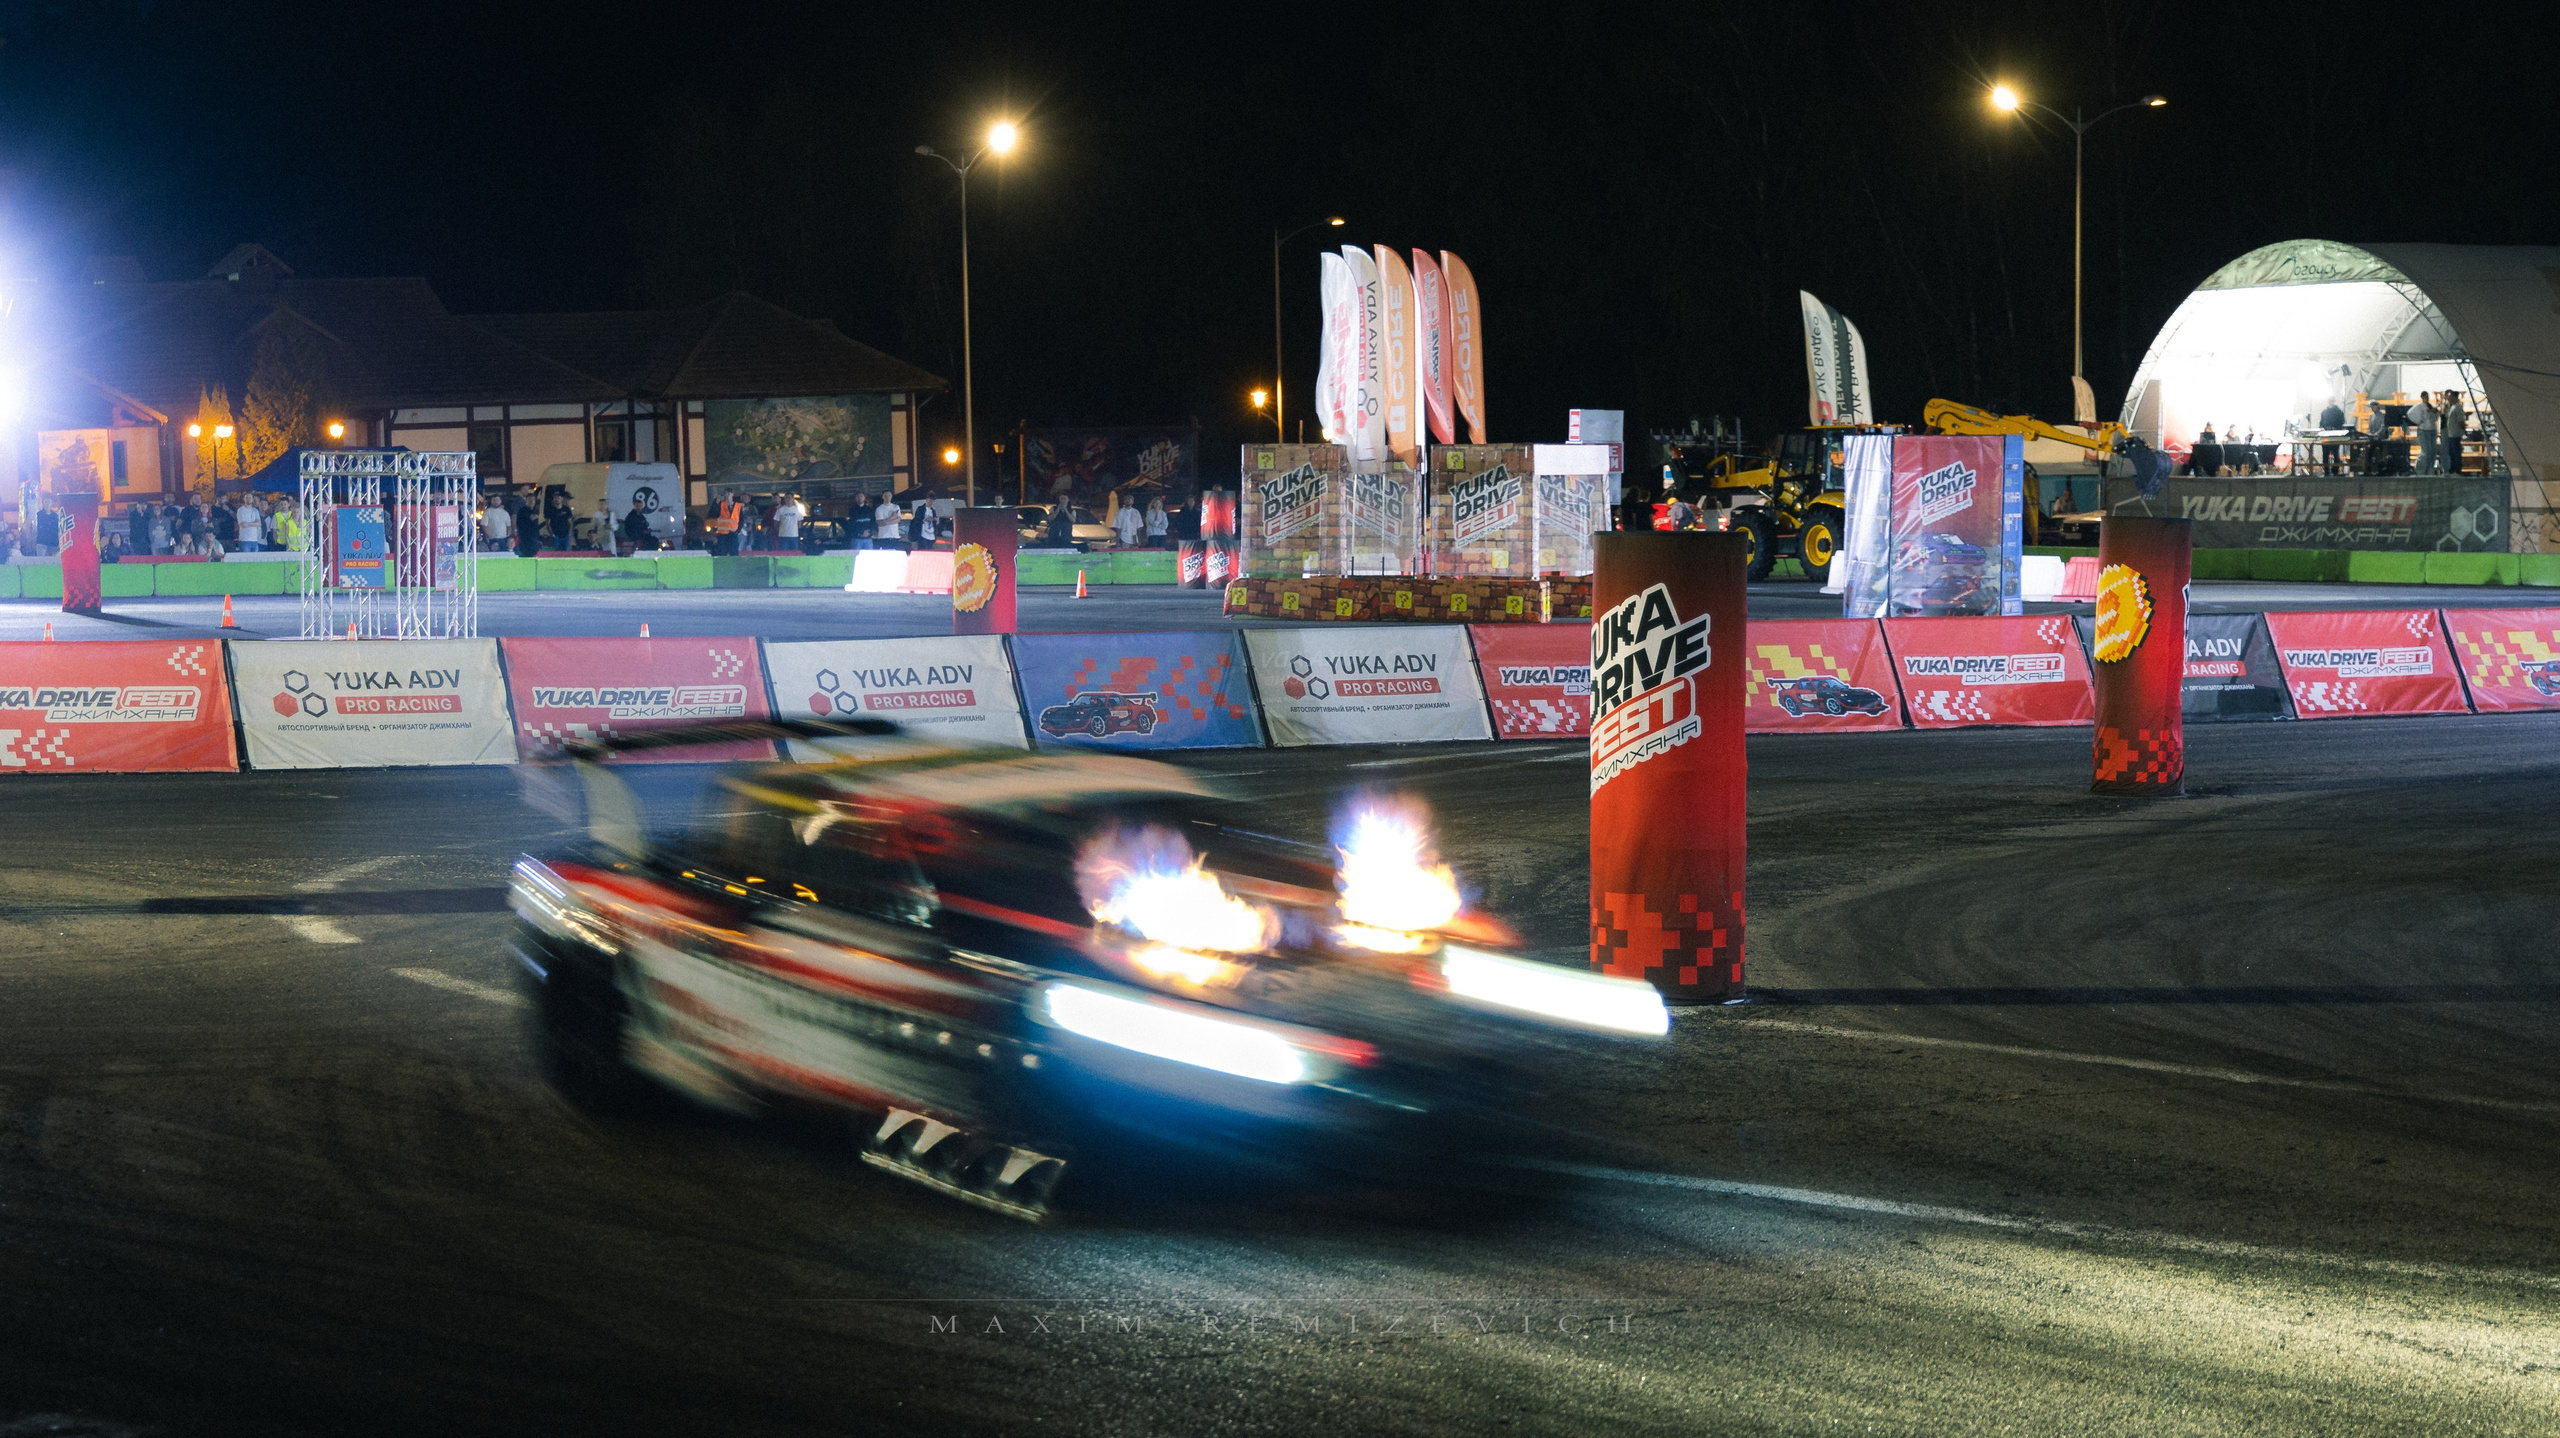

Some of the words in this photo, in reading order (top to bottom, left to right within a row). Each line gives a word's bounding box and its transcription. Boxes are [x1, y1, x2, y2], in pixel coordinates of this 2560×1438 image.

[1260, 464, 1315, 501] YUKA
[1450, 465, 1509, 503] YUKA
[1920, 463, 1964, 491] YUKA
[1922, 472, 1974, 505] DRIVE
[635, 491, 658, 510] 86
[1264, 475, 1327, 521] DRIVE
[1455, 478, 1520, 521] DRIVE
[1924, 489, 1967, 517] FEST
[1267, 499, 1320, 535] FEST
[2180, 496, 2246, 522] YUKA
[2249, 496, 2334, 522] DRIVE
[2340, 498, 2416, 521] FEST
[1457, 501, 1514, 538] FEST
[2259, 526, 2411, 543] ДЖИМХАНА
[1592, 588, 1677, 670] UKA
[2205, 638, 2242, 657] ADV
[1324, 655, 1389, 675] YUKA
[1393, 654, 1437, 673] ADV
[1906, 659, 1950, 673] YUKA
[1953, 658, 2006, 673] DRIVE
[2013, 657, 2059, 671] FEST
[2286, 652, 2327, 666] YUKA
[2330, 652, 2377, 666] DRIVE
[2385, 650, 2428, 664] FEST
[853, 667, 922, 688] YUKA
[927, 665, 973, 685] ADV
[1501, 669, 1550, 684] YUKA
[1965, 672, 2063, 683] ДЖИМХАНА
[2190, 663, 2239, 675] RACING
[2341, 665, 2431, 676] ДЖИМХАНА
[324, 671, 402, 690] YUKA
[408, 669, 460, 689] ADV
[1343, 682, 1373, 694] PRO
[1377, 680, 1433, 693] RACING
[35, 690, 117, 707] DRIVE
[124, 691, 193, 706] FEST
[345, 699, 381, 712] PRO
[386, 698, 452, 711] RACING
[534, 690, 595, 706] YUKA
[599, 690, 671, 705] DRIVE
[679, 689, 741, 704] FEST
[873, 696, 904, 709] PRO
[909, 692, 967, 707] RACING
[50, 709, 195, 720] ДЖИМХАНА
[613, 705, 743, 717] ДЖИМХАНА
[1290, 705, 1344, 713] АВТОСПОРТИВНЫЙ
[1345, 706, 1366, 714] БРЕНД
[1372, 704, 1413, 712] ОРГАНИЗАТОР
[1414, 702, 1450, 711] ДЖИМХАНЫ
[277, 722, 345, 732] АВТОСПОРТИВНЫЙ
[346, 724, 370, 732] БРЕНД
[379, 723, 428, 731] ОРГАНИЗАТОР
[429, 722, 472, 731] ДЖИМХАНЫ
[948, 715, 986, 724] ДЖИМХАНЫ
